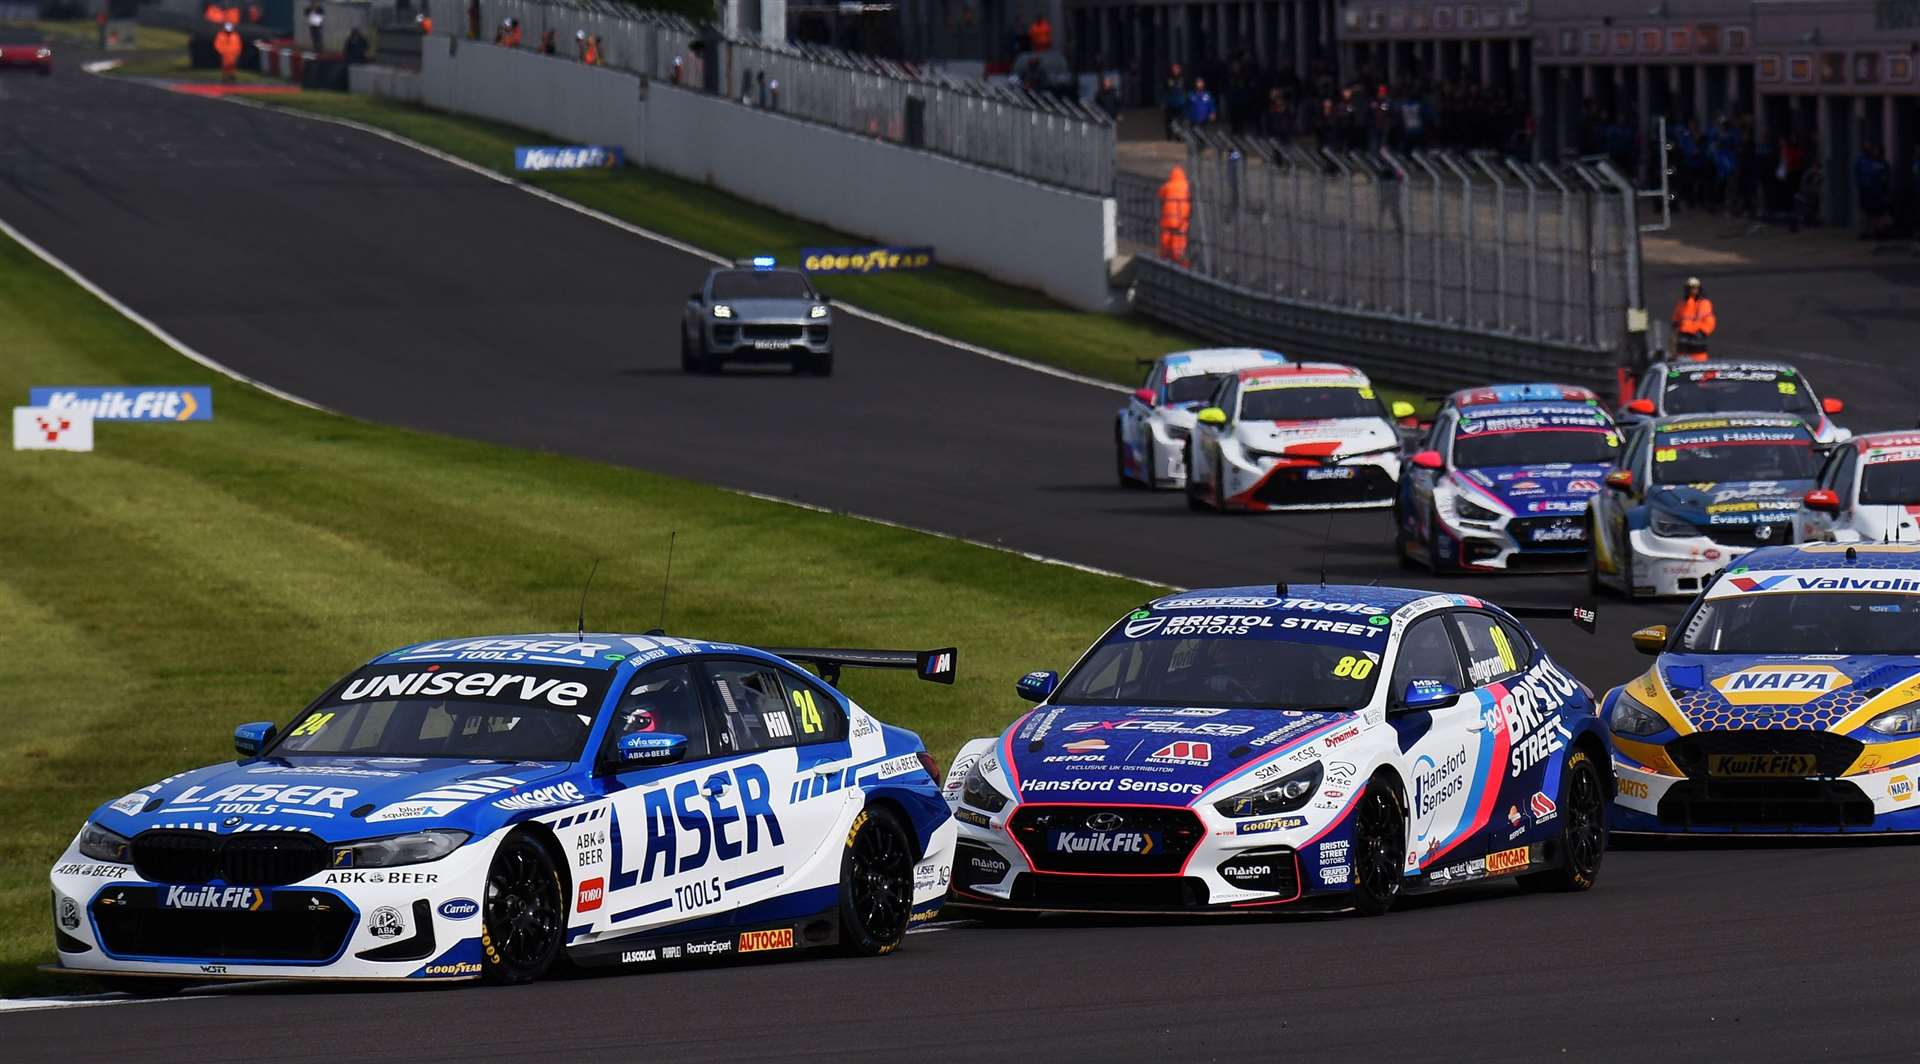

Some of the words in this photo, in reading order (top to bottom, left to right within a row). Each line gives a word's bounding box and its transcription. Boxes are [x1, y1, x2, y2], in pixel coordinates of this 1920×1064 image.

[805, 249, 929, 272] GOODYEAR
[1669, 435, 1719, 446] Evans
[1723, 432, 1796, 443] Halshaw
[1282, 598, 1386, 615] Tools
[1160, 626, 1250, 636] MOTORS
[1167, 615, 1274, 627] BRISTOL
[1280, 617, 1384, 638] STREET
[411, 637, 611, 658] LASER
[456, 651, 525, 661] TOOLS
[1333, 655, 1374, 680] 80
[1731, 673, 1828, 690] NAPA
[792, 690, 824, 734] 24
[289, 712, 336, 737] 24
[763, 710, 793, 738] Hill
[1512, 713, 1573, 778] STREET
[628, 752, 645, 760] ABK
[651, 749, 671, 759] BEER
[881, 762, 895, 777] ABK
[901, 755, 919, 773] BEER
[1122, 765, 1175, 773] DISTRIBUTOR
[1145, 757, 1187, 765] MILLERS
[1187, 759, 1210, 767] OILS
[1422, 743, 1467, 793] Hansford
[1020, 778, 1113, 792] Hansford
[1118, 778, 1204, 795] Sensors
[1326, 775, 1352, 786] WSC
[1422, 773, 1464, 818] Sensors
[1890, 782, 1911, 795] NAPA
[170, 784, 359, 810] LASER
[213, 803, 280, 815] TOOLS
[382, 810, 422, 819] square
[398, 805, 424, 813] blue
[609, 763, 785, 893] LASER
[1243, 818, 1301, 832] GOODYEAR
[576, 832, 597, 850] ABK
[1319, 840, 1350, 851] BRISTOL
[578, 848, 604, 867] BEER
[1319, 848, 1348, 859] STREET
[1488, 849, 1526, 871] AUTOCAR
[971, 858, 1006, 871] MARON
[1319, 857, 1346, 866] MOTORS
[55, 864, 83, 876] ABK
[92, 864, 128, 879] BEER
[1224, 865, 1271, 876] MARON
[1323, 867, 1349, 877] DRAPER
[325, 872, 367, 884] ABK
[388, 873, 439, 884] BEER
[1323, 874, 1349, 885] Tools
[579, 887, 602, 903] TORO
[675, 876, 723, 913] TOOLS
[443, 901, 476, 915] Carrier
[377, 927, 397, 935] ABK
[739, 931, 792, 951] AUTOCAR
[425, 961, 483, 975] GOODYEAR
